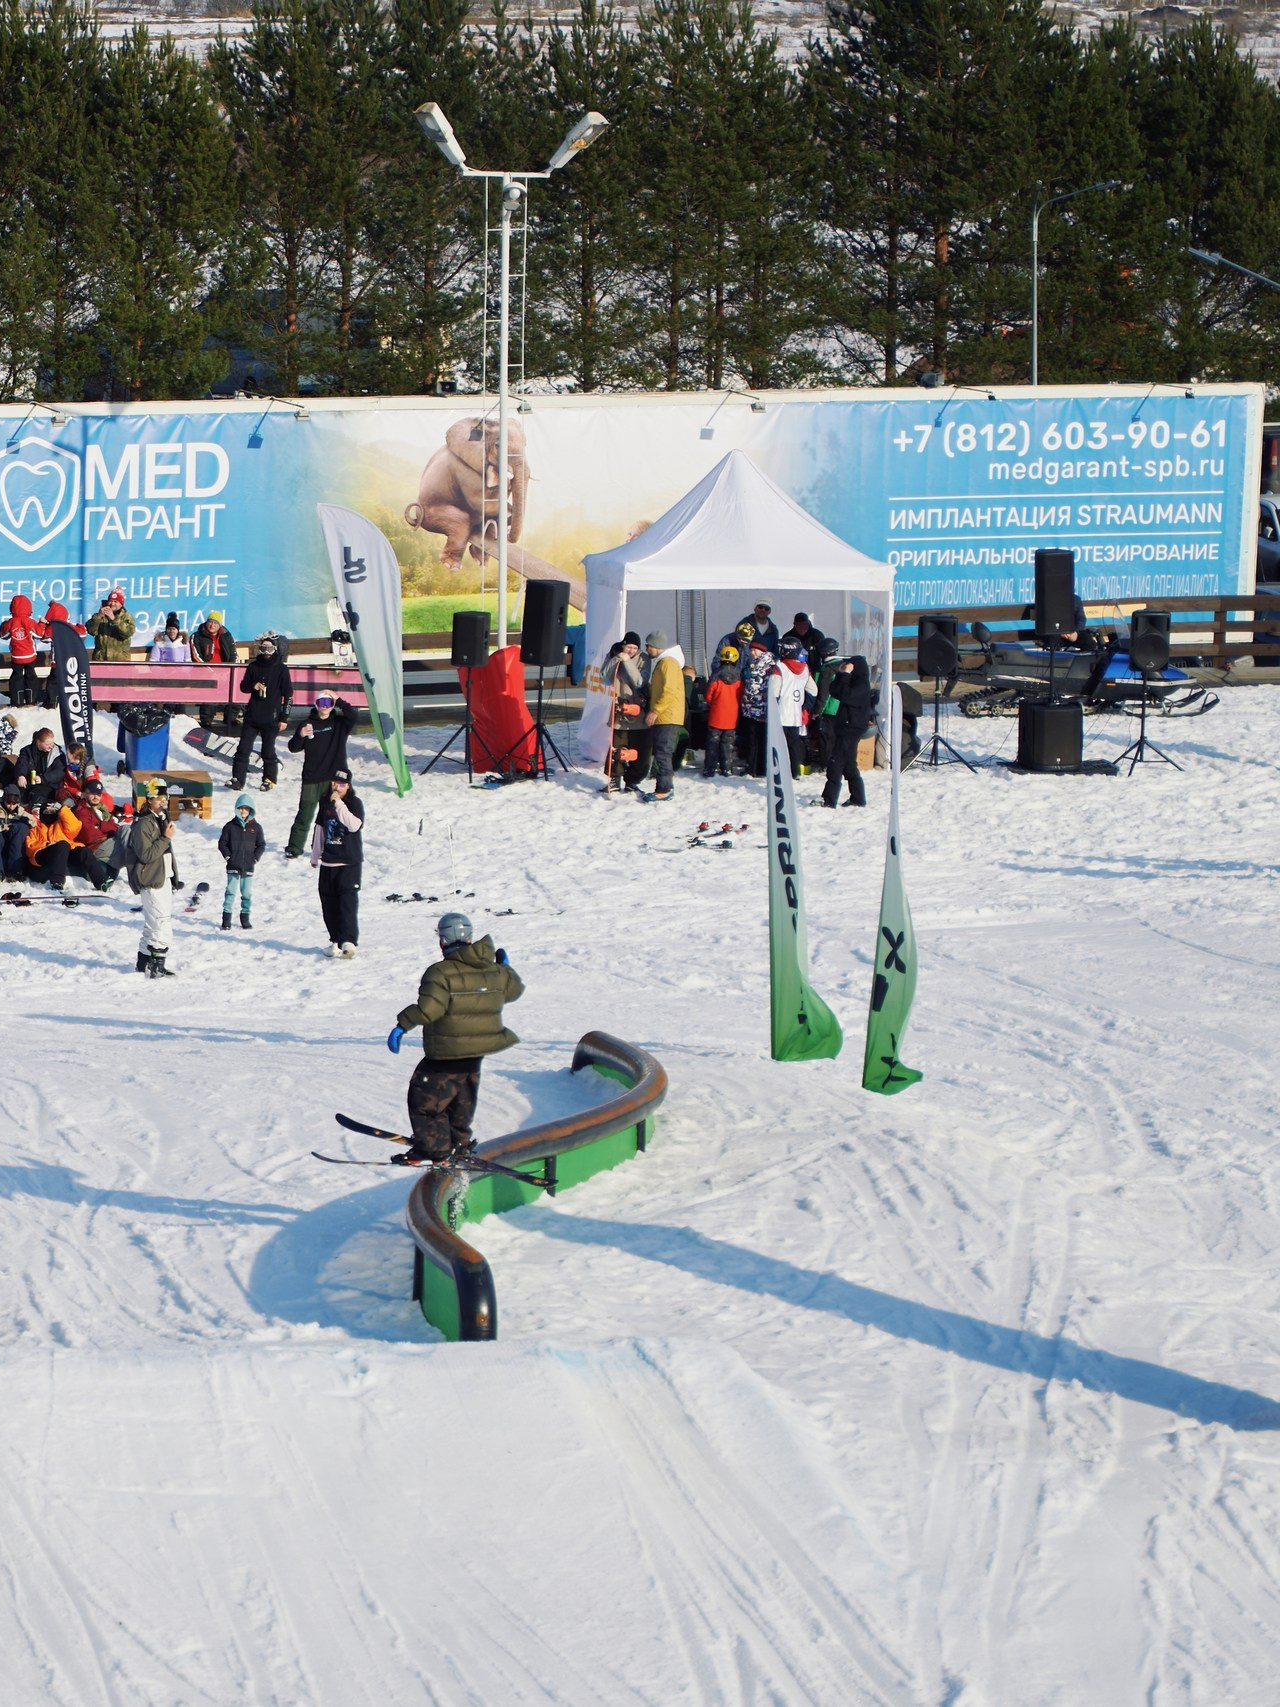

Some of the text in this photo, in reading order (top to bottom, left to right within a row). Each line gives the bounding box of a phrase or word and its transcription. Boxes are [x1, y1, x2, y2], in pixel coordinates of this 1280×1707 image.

[892, 419, 1226, 458] +7 (812) 603-90-61
[85, 442, 230, 500] MED
[988, 456, 1225, 485] medgarant-spb.ru
[83, 503, 226, 542] ГАРАНТ
[889, 502, 1223, 531] ИМПЛАНТАЦИЯ STRAUMANN
[887, 547, 1039, 567] ОРИГИНАЛЬНОЕ
[80, 672, 88, 702] DRINK
[792, 689, 801, 703] 9
